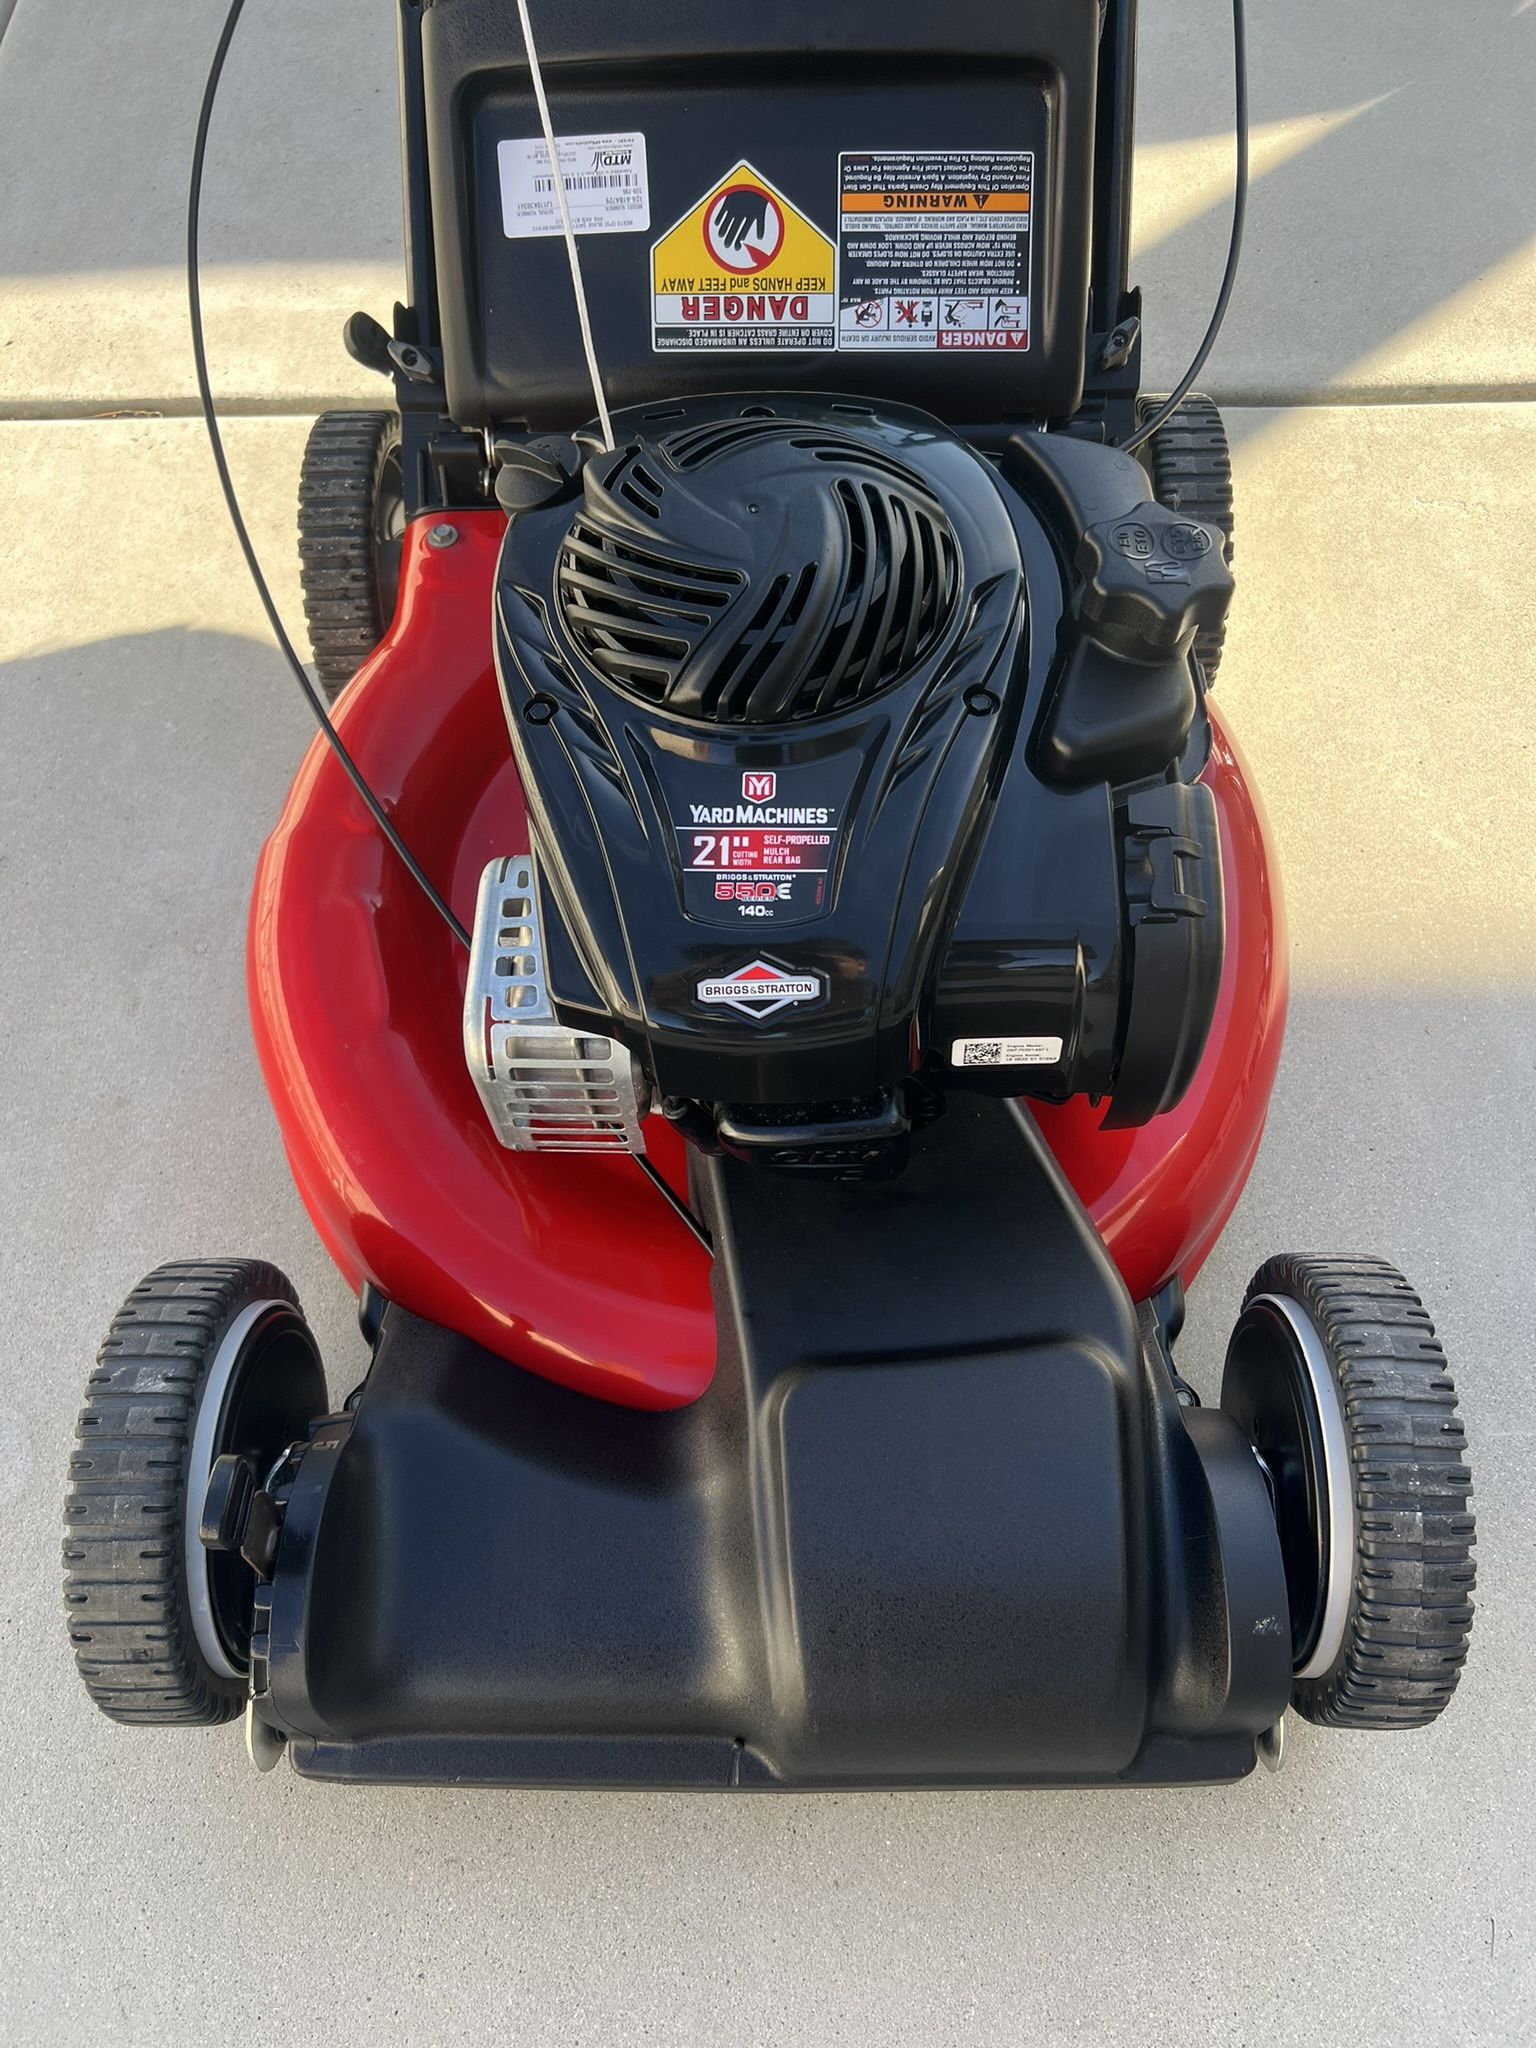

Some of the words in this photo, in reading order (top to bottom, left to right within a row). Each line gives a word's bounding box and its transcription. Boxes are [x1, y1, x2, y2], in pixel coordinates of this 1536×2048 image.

[604, 154, 631, 166] MTD
[872, 155, 914, 163] Requirements.
[884, 195, 966, 207] WARNING
[662, 278, 694, 292] AWAY
[700, 278, 726, 292] FEET
[730, 278, 749, 291] and
[753, 277, 792, 291] HANDS
[796, 277, 825, 291] KEEP
[682, 296, 808, 321] DANGER
[687, 329, 708, 337] PLACE.
[710, 329, 717, 337] IN
[719, 329, 725, 337] IS
[727, 329, 755, 337] CATCHER
[757, 329, 777, 337] GRASS
[779, 329, 799, 337] ENTIRE
[801, 329, 810, 337] OR
[812, 329, 832, 337] COVER
[657, 338, 692, 346] DISCHARGE
[695, 338, 736, 346] UNDAMAGED
[738, 338, 747, 346] AN
[750, 338, 775, 346] UNLESS
[778, 337, 806, 346] OPERATE
[809, 337, 821, 346] NOT
[823, 337, 832, 346] DO
[842, 335, 859, 343] DEATH
[943, 332, 1006, 345] DANGER
[689, 804, 734, 823] YARD
[763, 835, 830, 845] SELF-PROPELLED
[733, 850, 759, 858] CUTTING
[763, 847, 790, 856] MULCH
[733, 859, 752, 867] WIDTH
[763, 856, 784, 865] REAR
[785, 856, 801, 865] BAG
[705, 983, 812, 996] BRIGGS&STRATTON
